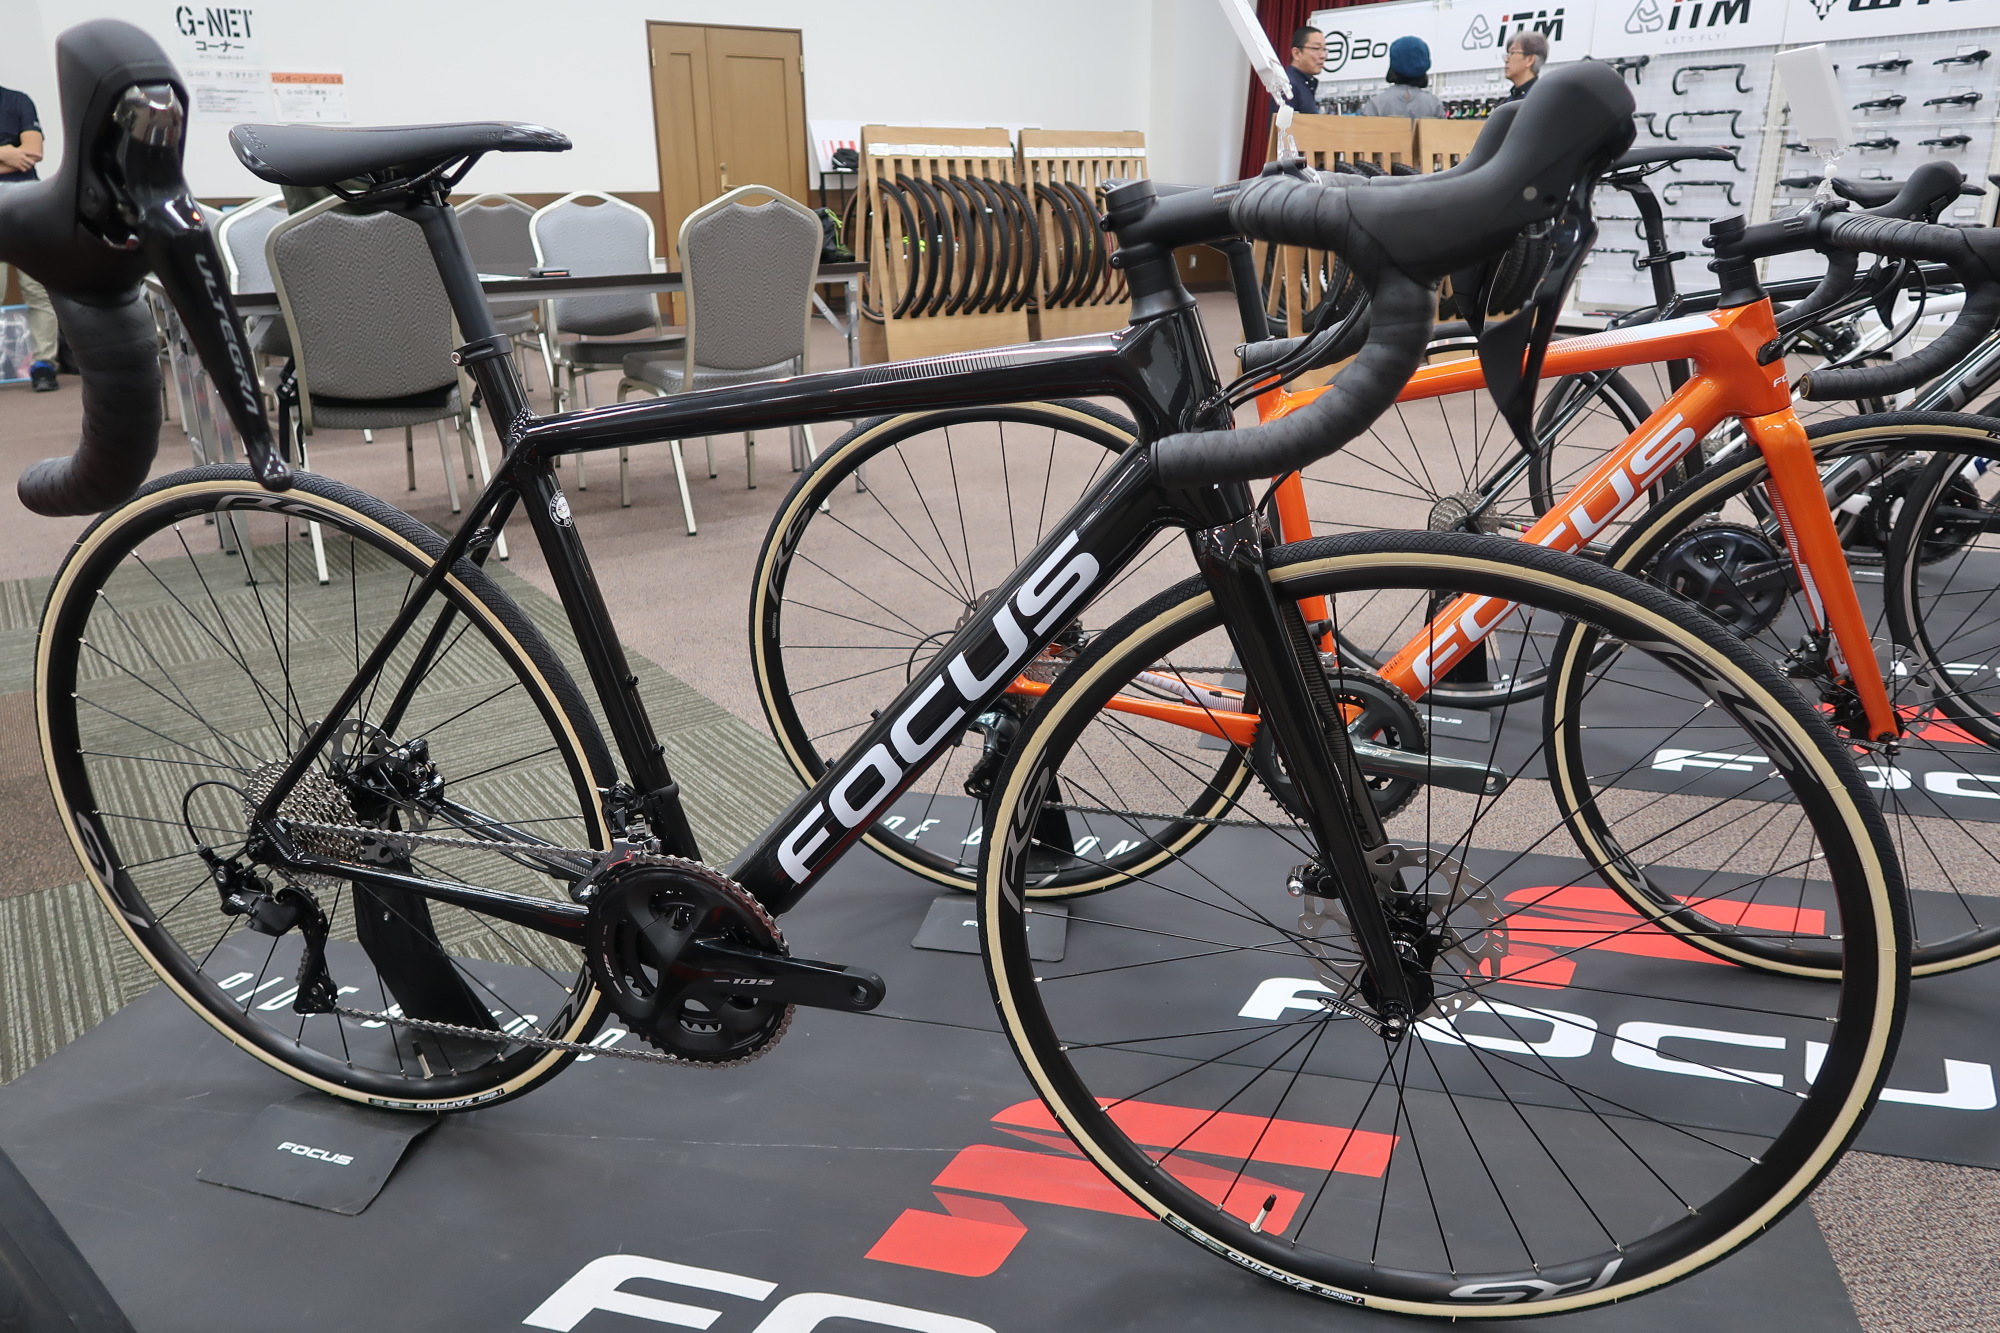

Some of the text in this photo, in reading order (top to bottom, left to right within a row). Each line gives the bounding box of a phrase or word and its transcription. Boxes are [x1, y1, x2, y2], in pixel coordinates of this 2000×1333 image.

[176, 5, 252, 38] G-NET
[195, 40, 245, 53] コーナー
[195, 253, 259, 415] ULTEGRA
[777, 530, 1100, 885] FOCUS
[732, 978, 776, 986] 105
[277, 1140, 355, 1167] FOCUS
[1227, 1251, 1313, 1290] ZAFFIRO
[1321, 1287, 1354, 1302] vittoria
